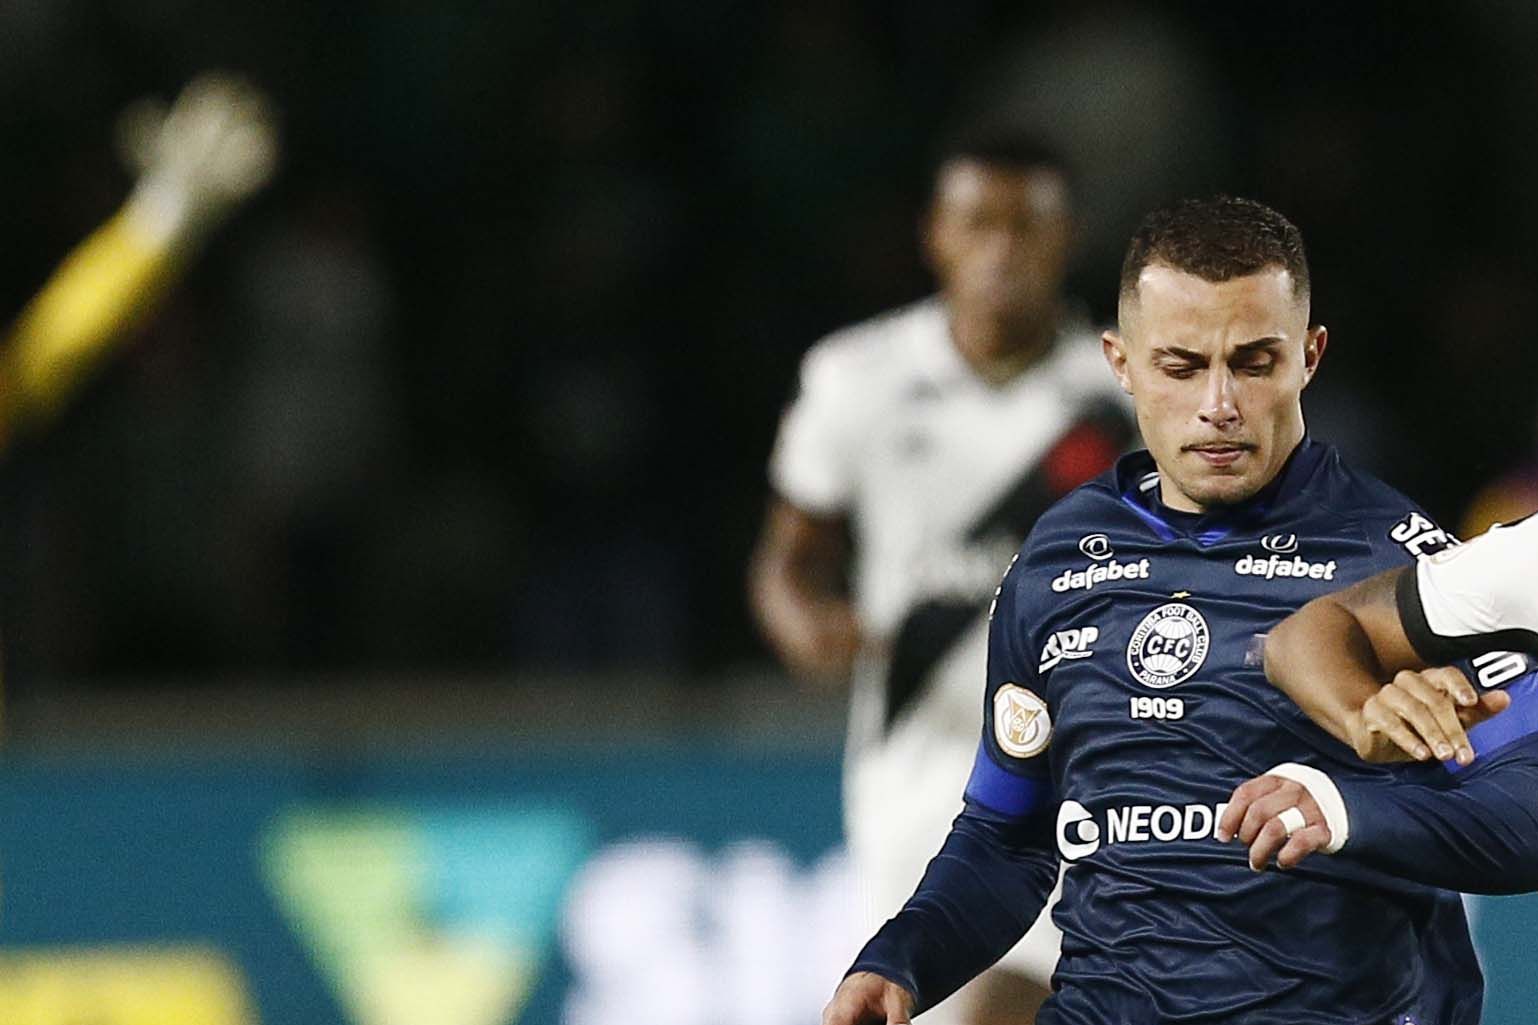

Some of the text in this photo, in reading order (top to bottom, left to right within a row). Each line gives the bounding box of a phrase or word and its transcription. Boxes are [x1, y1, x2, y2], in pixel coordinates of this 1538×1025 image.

[1051, 559, 1150, 592] dafabet
[1235, 555, 1336, 580] dafabet
[1161, 606, 1187, 617] FOOT
[1147, 635, 1191, 658] CFC
[1130, 697, 1184, 720] 1909
